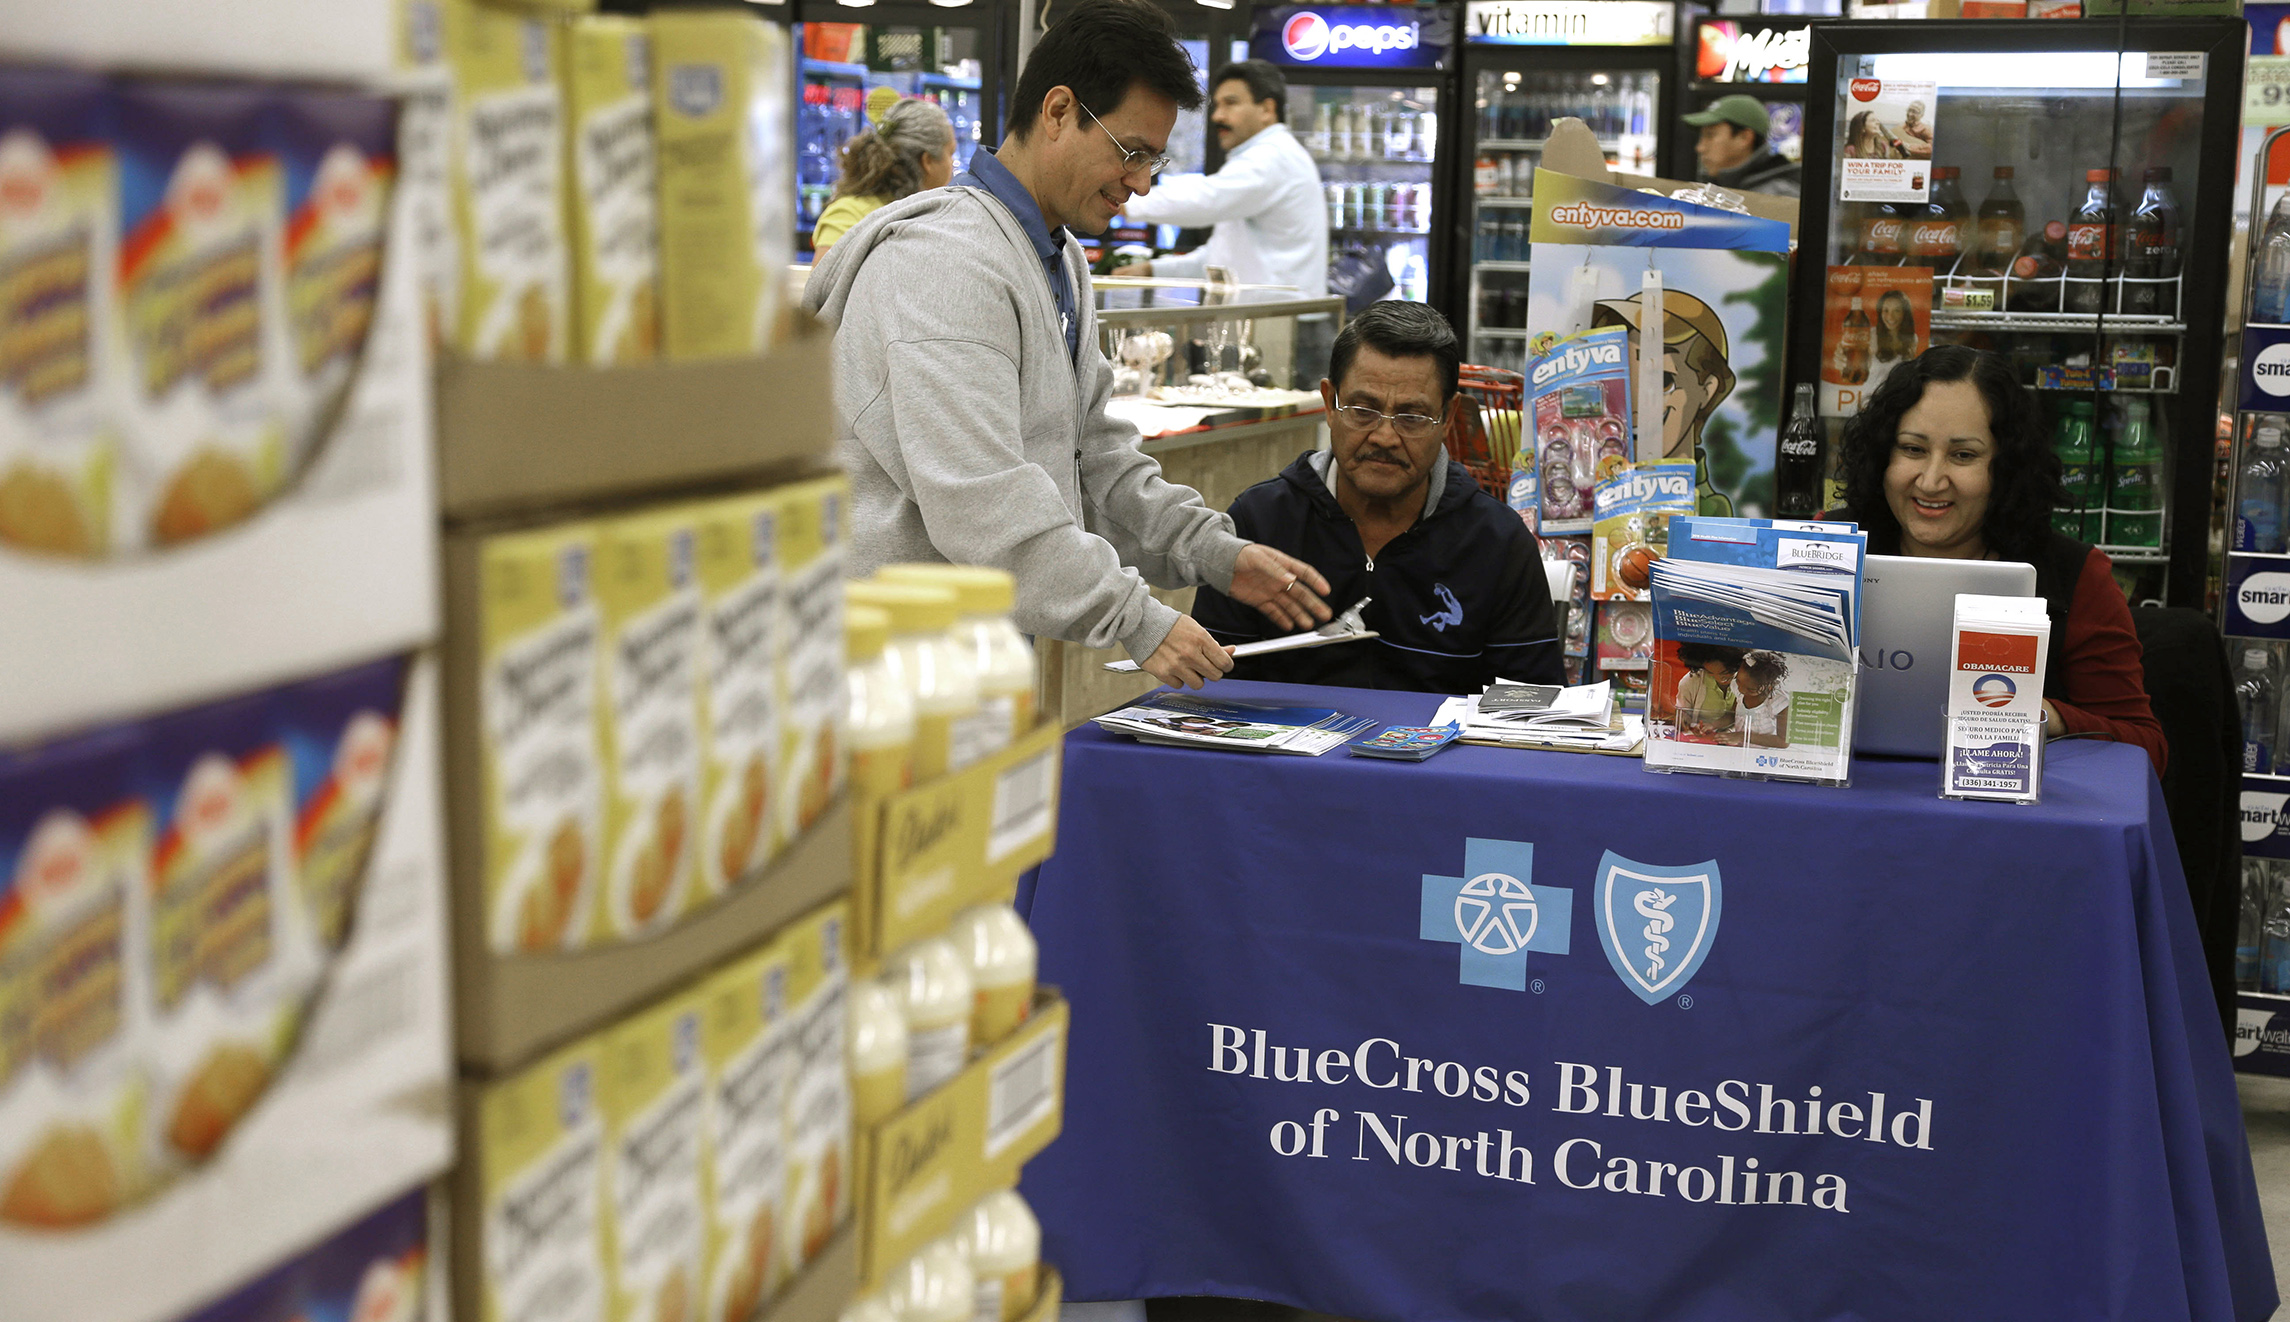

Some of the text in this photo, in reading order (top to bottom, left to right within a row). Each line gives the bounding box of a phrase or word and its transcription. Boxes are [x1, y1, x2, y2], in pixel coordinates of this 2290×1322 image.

[1477, 6, 1587, 36] vitamin
[1329, 21, 1419, 54] pepsi
[1552, 202, 1684, 229] entyva.com
[1966, 294, 1992, 308] $1.59
[1532, 344, 1621, 385] entyva
[1781, 439, 1816, 455] Coca-Cola
[2061, 471, 2086, 487] Sprite
[2117, 474, 2143, 488] Sprite
[1597, 475, 1688, 507] entyva
[2241, 590, 2290, 604] smar
[1673, 609, 1756, 626] BlueAdvantage
[1674, 615, 1735, 627] BlueSelect
[1676, 620, 1731, 632] BlueValue
[1678, 632, 1712, 640] individuals
[1727, 637, 1754, 645] families
[1963, 663, 2029, 672] OBAMACARE
[1962, 778, 2017, 788] (336) 341-1957
[1206, 1022, 1934, 1151] BlueCross BlueShield
[1270, 1107, 1850, 1214] of North Carolina
